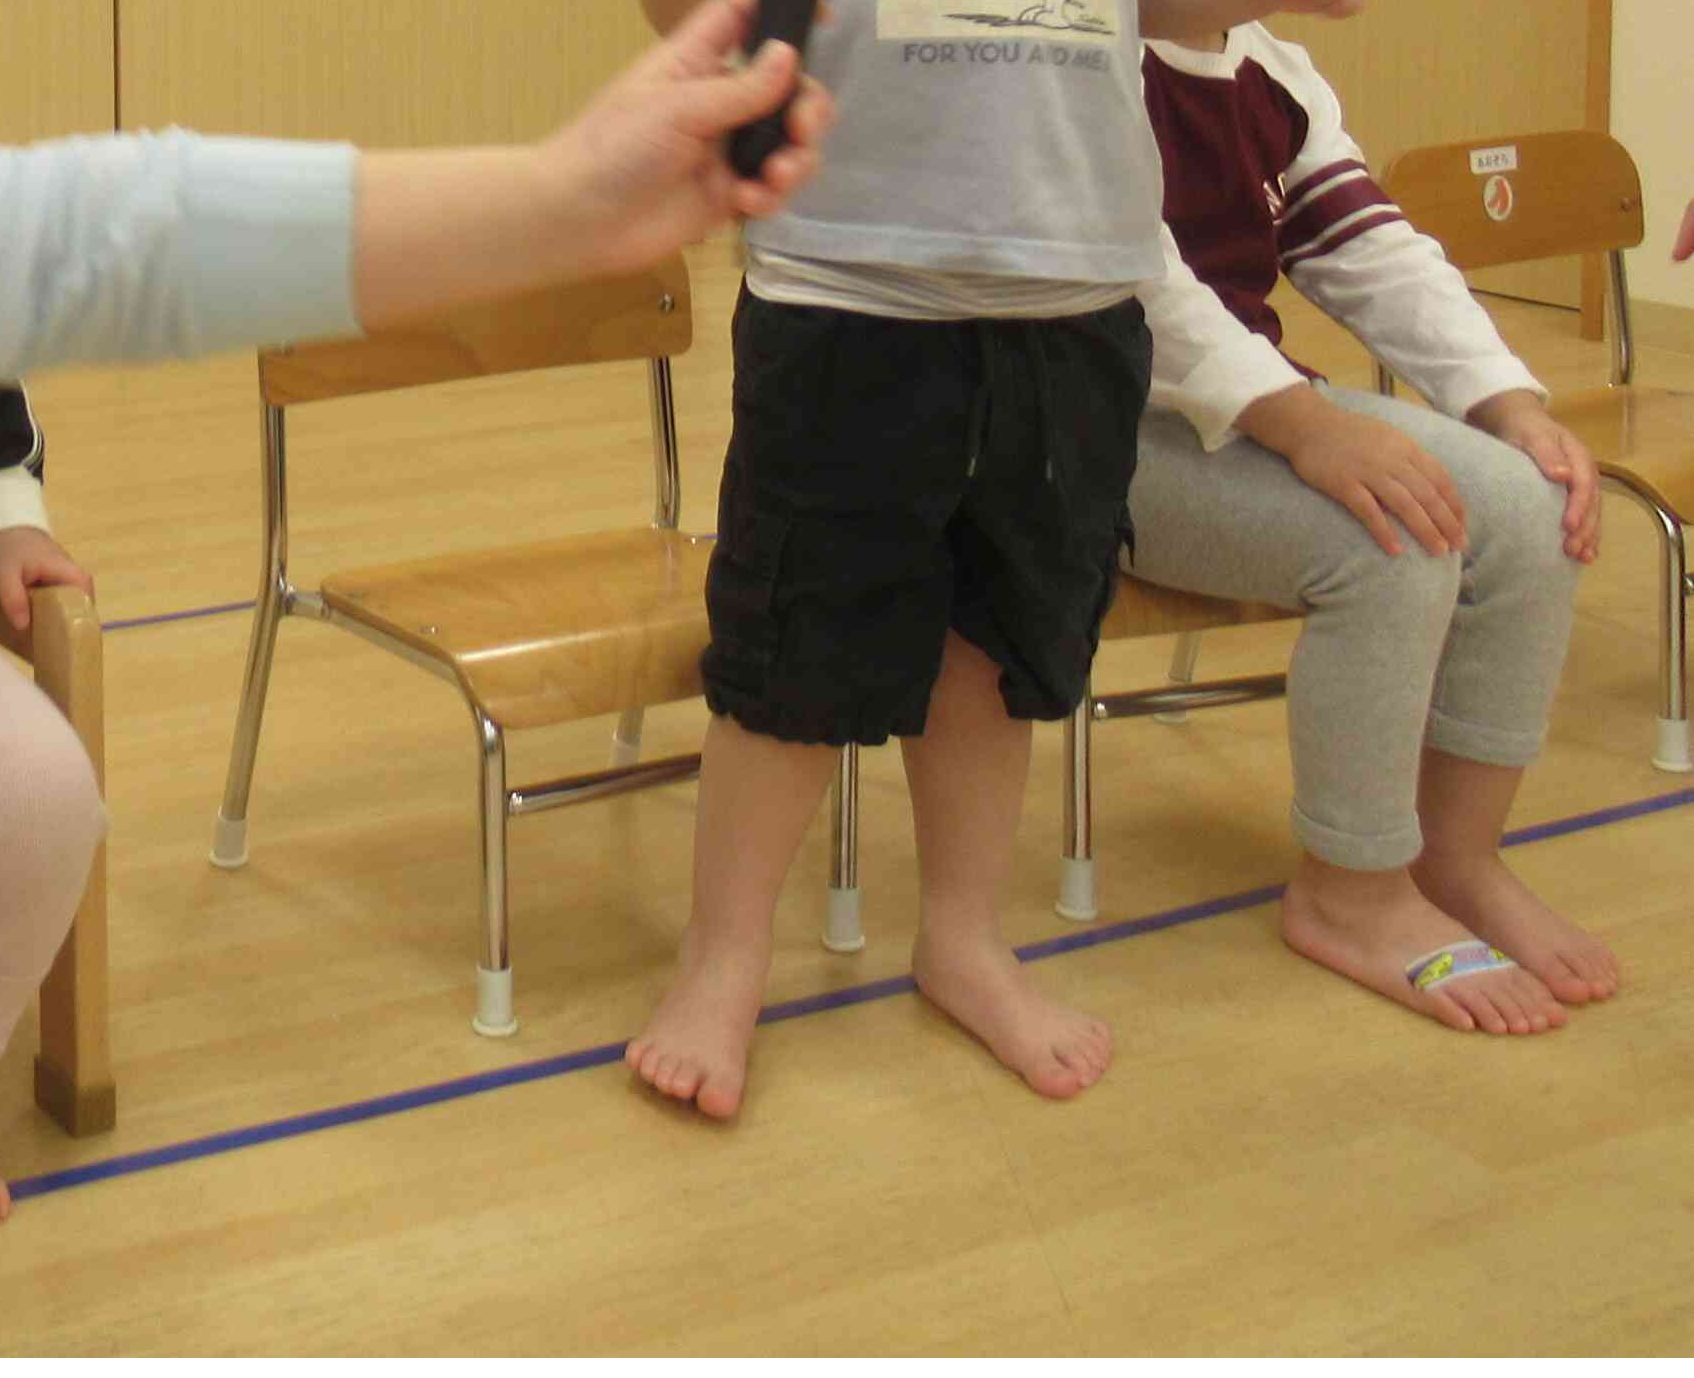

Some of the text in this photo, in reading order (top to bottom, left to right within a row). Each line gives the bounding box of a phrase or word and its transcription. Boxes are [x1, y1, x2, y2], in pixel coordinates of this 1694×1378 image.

[903, 43, 955, 63] FOR
[963, 42, 1020, 63] YOU
[1027, 44, 1069, 66] AD
